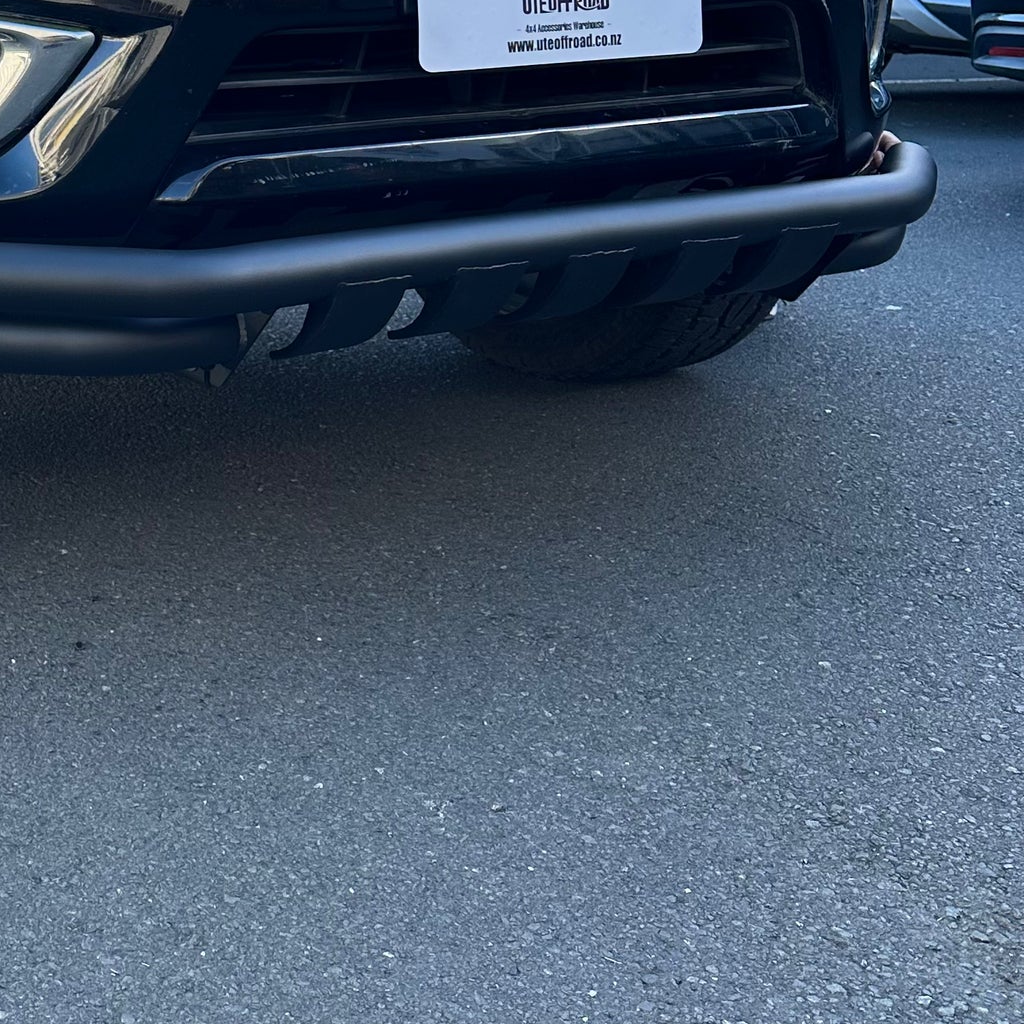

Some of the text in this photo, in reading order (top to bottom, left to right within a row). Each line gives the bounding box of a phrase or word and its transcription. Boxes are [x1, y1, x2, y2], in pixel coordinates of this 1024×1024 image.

[525, 20, 605, 34] 4x4 Accessories Warehouse
[507, 33, 622, 53] www.uteoffroad.co.nz
